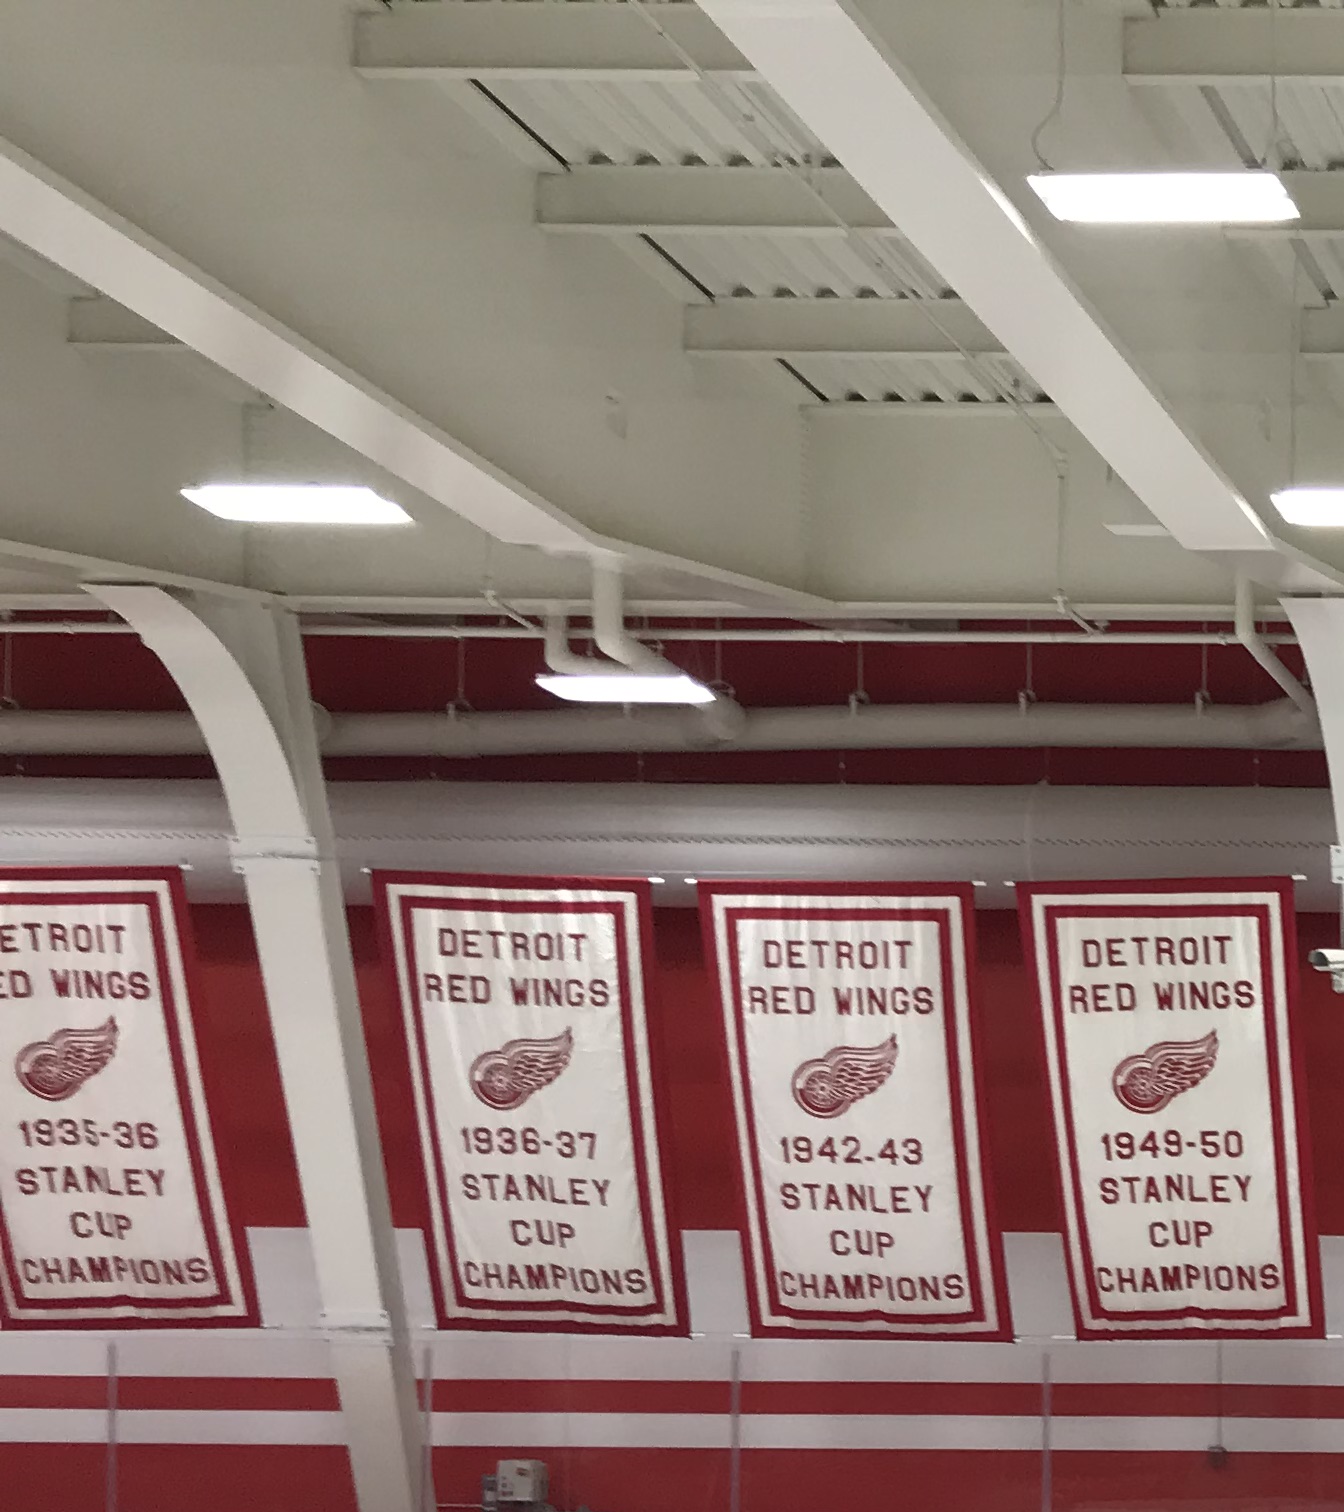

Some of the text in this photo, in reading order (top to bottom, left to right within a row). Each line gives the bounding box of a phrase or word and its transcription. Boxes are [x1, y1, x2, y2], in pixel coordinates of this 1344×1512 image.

[0, 922, 126, 954] ETROIT
[438, 927, 588, 962] DETROIT
[1081, 935, 1233, 968] DETROIT
[763, 939, 914, 970] DETROIT
[0, 968, 151, 1001] ED WINGS
[423, 972, 610, 1008] RED WINGS
[748, 985, 935, 1016] RED WINGS
[1069, 980, 1255, 1014] RED WINGS
[18, 1118, 159, 1150] 1935-36
[460, 1126, 597, 1160] 1936-37
[1101, 1129, 1244, 1162] 1949-50
[780, 1135, 923, 1166] 1942-43
[15, 1167, 167, 1199] STANLEY
[461, 1173, 610, 1207] STANLEY
[779, 1182, 933, 1214] STANLEY
[1099, 1173, 1252, 1205] STANLEY
[69, 1210, 132, 1241] CUP
[509, 1219, 576, 1249] CUP
[1148, 1219, 1213, 1249] CUP
[829, 1229, 895, 1259] CUP
[20, 1255, 212, 1286] CHAMPIONS
[462, 1259, 648, 1296] CHAMPIONS
[777, 1269, 965, 1303] CHAMPIONS
[1097, 1261, 1281, 1295] CHAMPIONS
